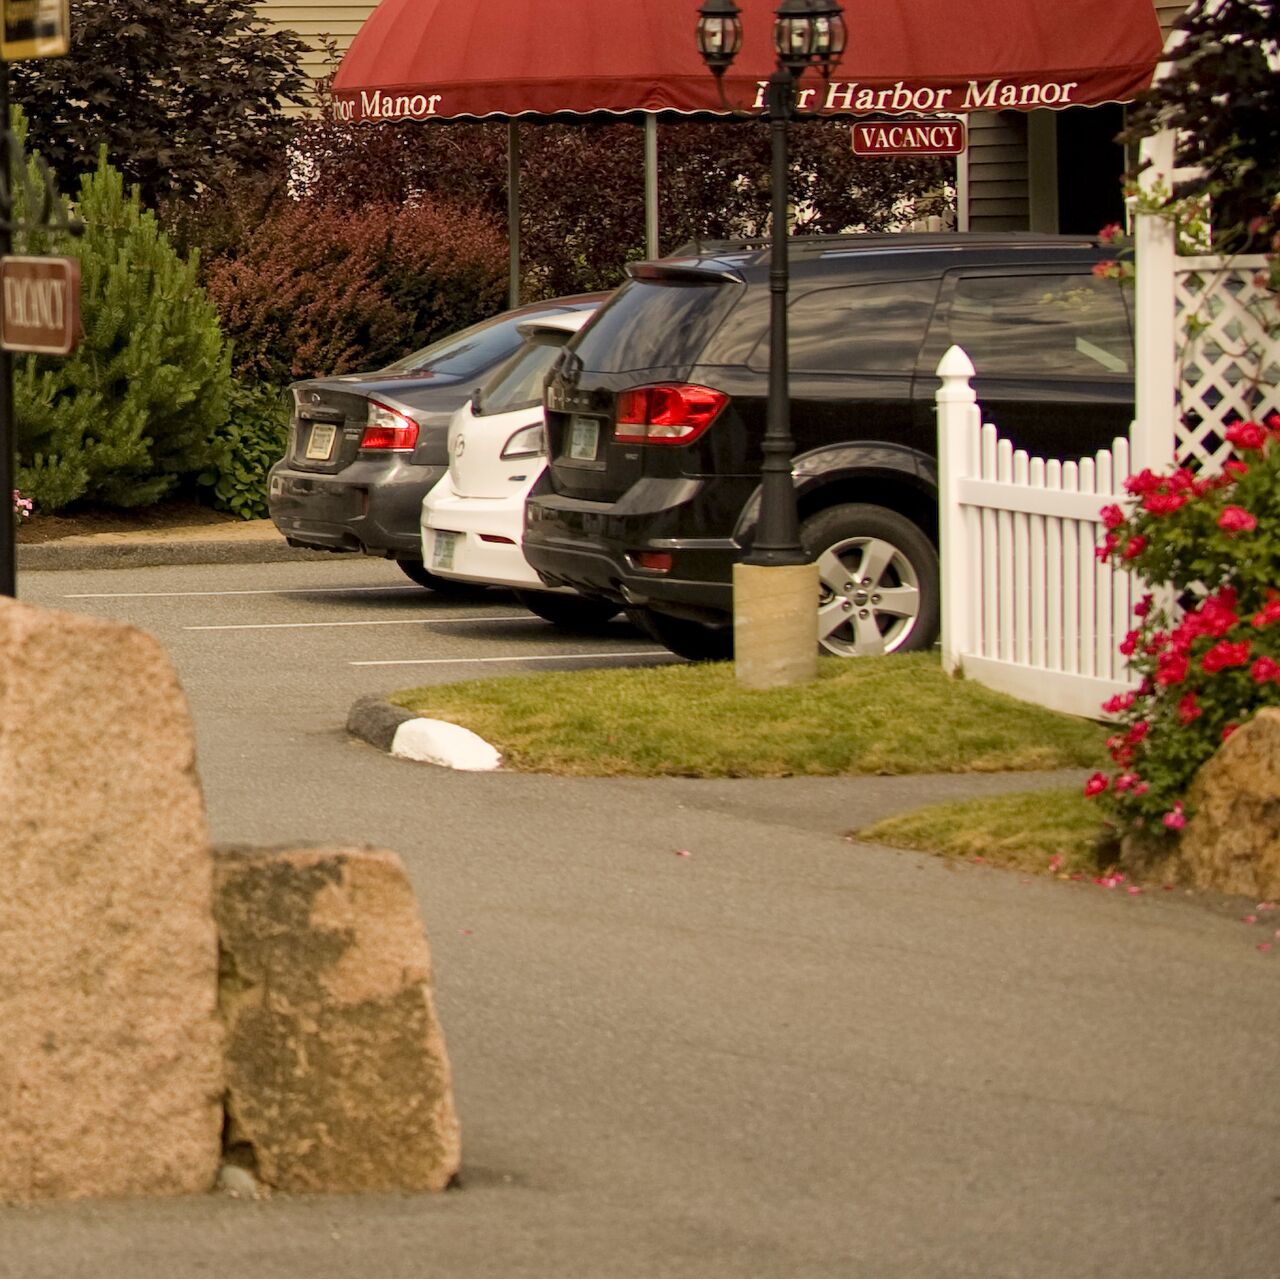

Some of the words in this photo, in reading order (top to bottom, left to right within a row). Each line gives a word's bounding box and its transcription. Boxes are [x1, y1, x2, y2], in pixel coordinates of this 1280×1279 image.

[360, 90, 442, 118] Manor
[823, 81, 953, 110] Harbor
[960, 79, 1078, 108] Manor
[860, 126, 958, 148] VACANCY
